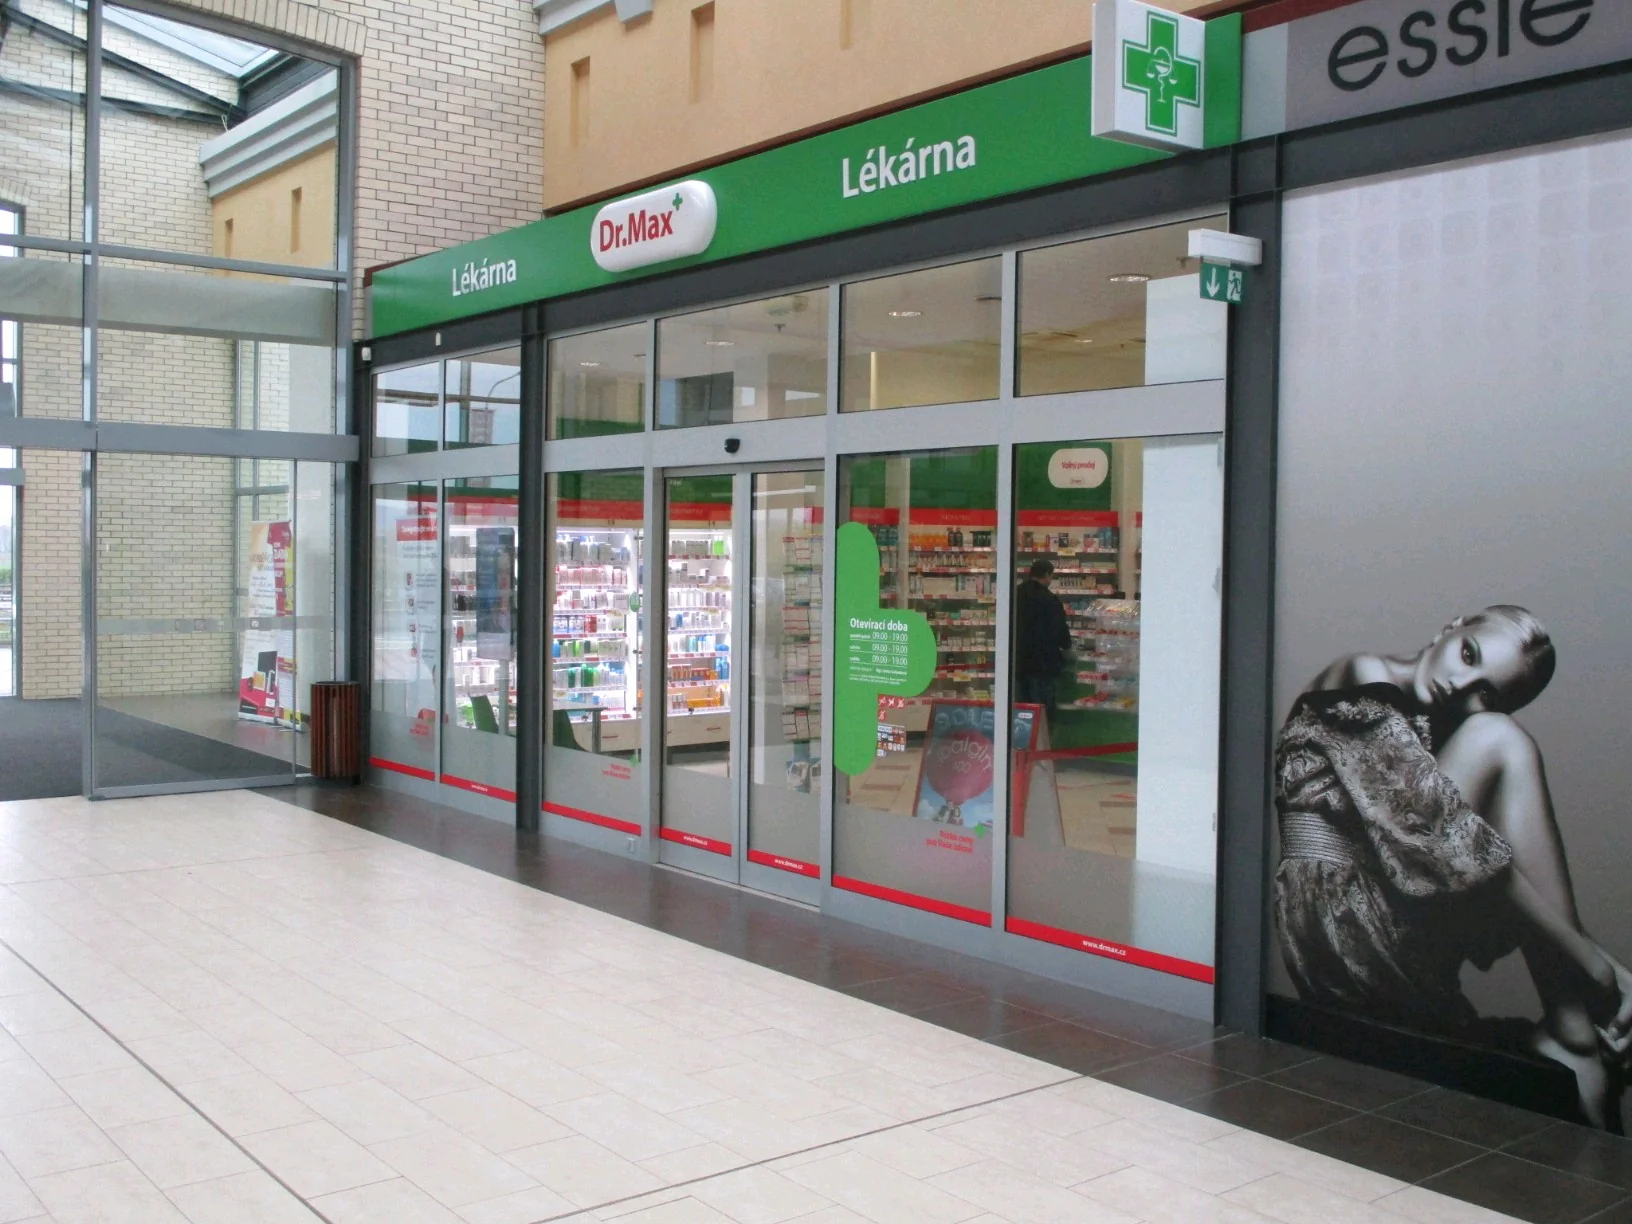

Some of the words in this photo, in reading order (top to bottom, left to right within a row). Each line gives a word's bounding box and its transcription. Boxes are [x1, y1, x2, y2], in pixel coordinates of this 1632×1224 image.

[1327, 0, 1594, 92] essie
[842, 134, 977, 199] Lékárna
[599, 209, 674, 252] Dr.Max
[452, 257, 517, 297] Lékárna
[850, 617, 886, 630] Otevírací
[887, 619, 908, 632] doba
[1082, 940, 1127, 956] www.drmax.cz
